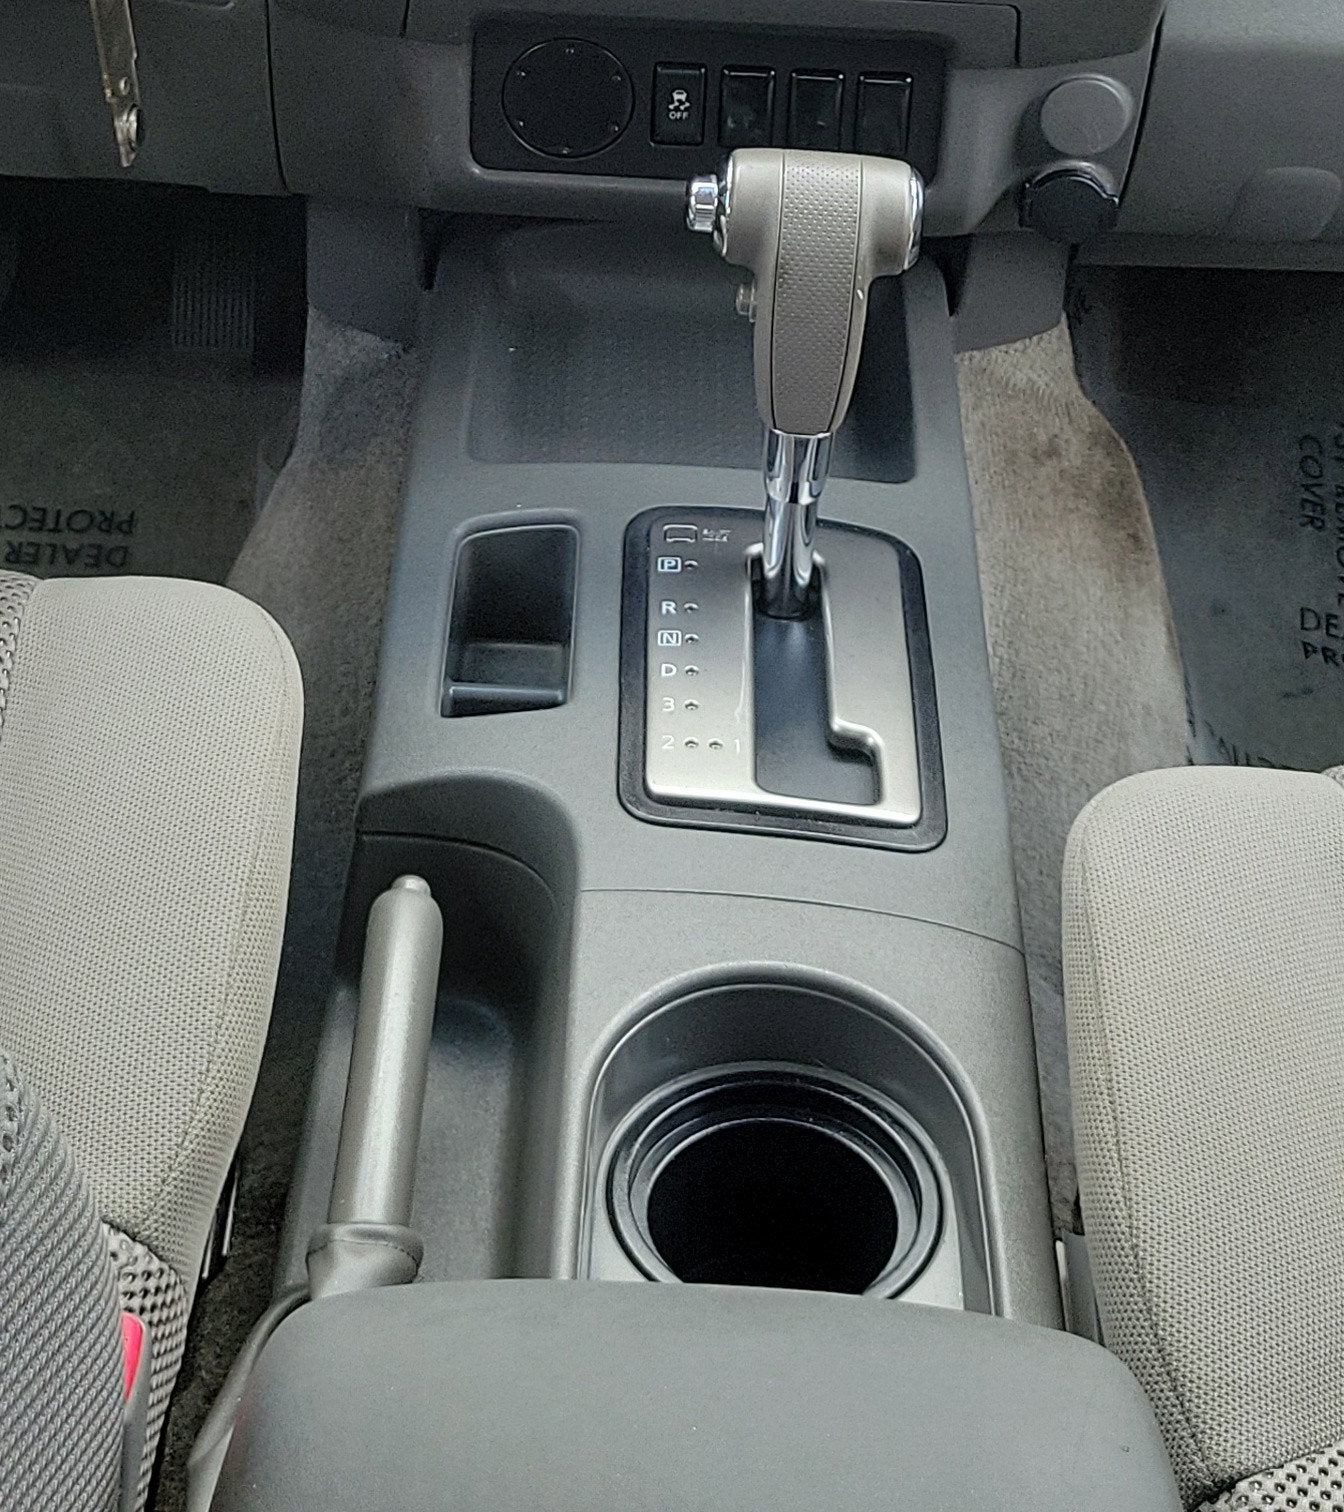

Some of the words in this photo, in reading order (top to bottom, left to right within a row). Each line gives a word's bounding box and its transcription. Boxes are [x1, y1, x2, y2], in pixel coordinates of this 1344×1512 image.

[669, 111, 689, 120] OFF
[1299, 433, 1326, 532] COVER
[5, 541, 131, 569] DEALER
[663, 559, 677, 570] P
[662, 601, 677, 615] R
[663, 632, 677, 645] N
[661, 664, 677, 677] D
[662, 698, 675, 712] 3
[662, 736, 675, 750] 2
[733, 739, 741, 754] 1
